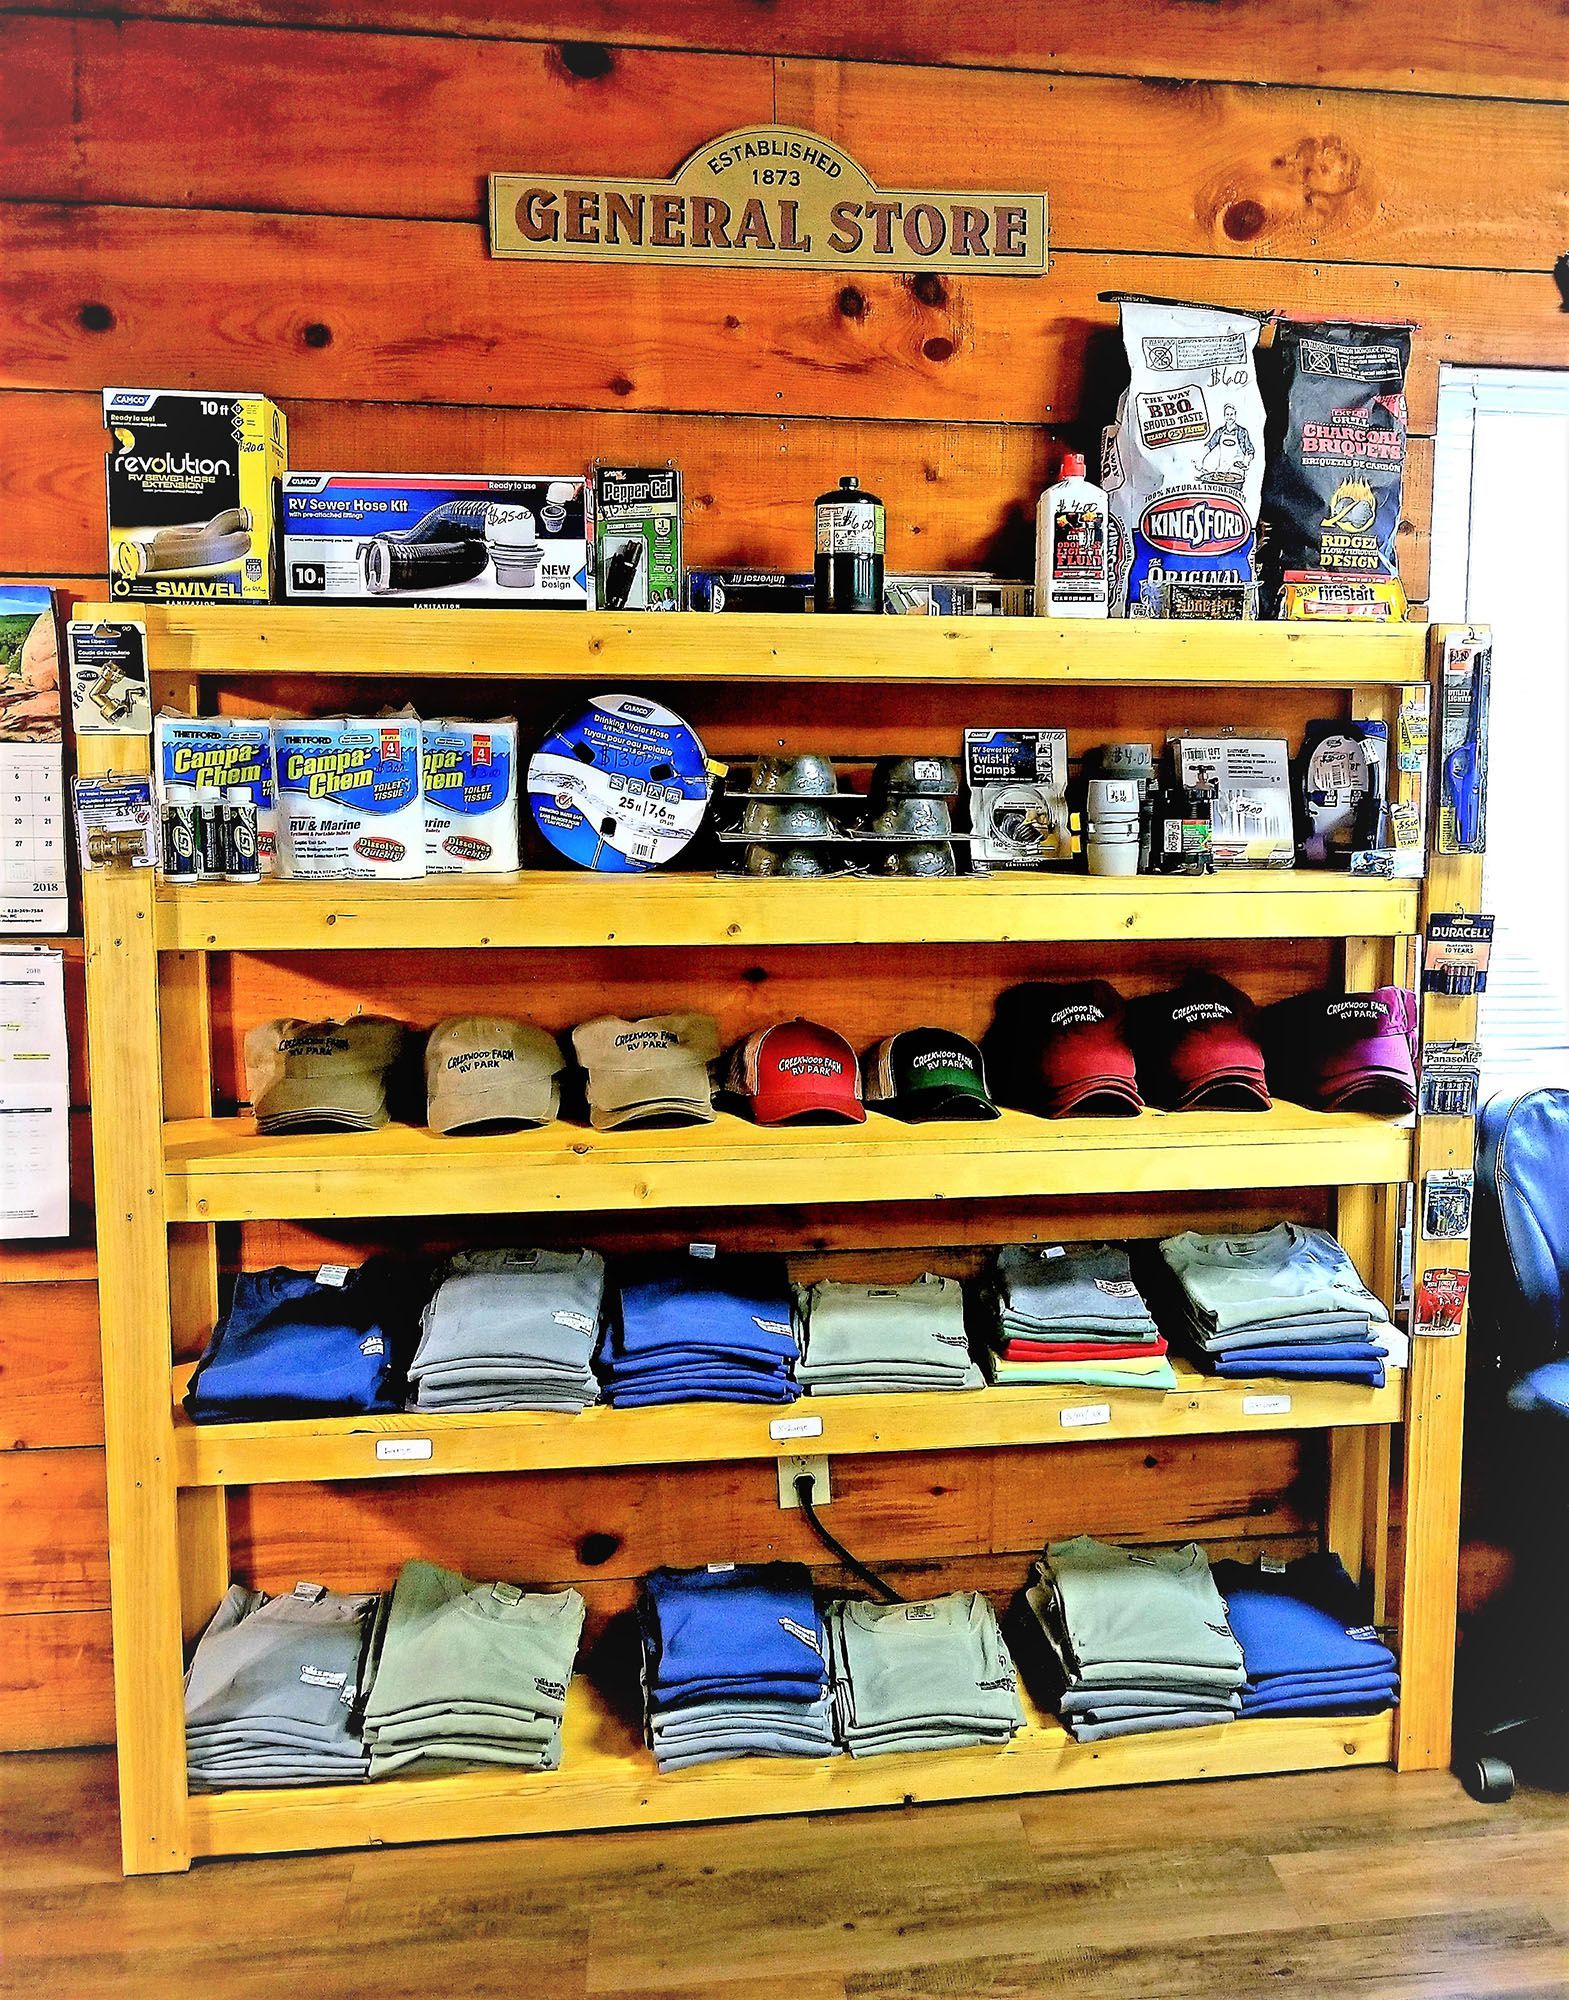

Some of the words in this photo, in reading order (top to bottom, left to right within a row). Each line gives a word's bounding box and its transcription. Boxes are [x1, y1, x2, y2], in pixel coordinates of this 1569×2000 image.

[706, 140, 844, 180] ESTABLISHED
[752, 169, 801, 187] 1873
[514, 188, 810, 253] GENERAL
[827, 202, 1028, 256] STORE
[116, 395, 144, 404] CAMCO
[1167, 390, 1191, 400] WAY
[201, 401, 216, 415] 10
[220, 404, 229, 415] ft
[1148, 399, 1194, 418] BBQ
[111, 414, 131, 422] Ready
[1143, 417, 1176, 431] SHOULD
[1178, 412, 1204, 425] TASTE
[1303, 424, 1400, 445] CHARCOAL
[1303, 438, 1400, 459] BRIQUETS
[114, 452, 230, 476] revolution
[145, 474, 183, 482] SEWER
[291, 478, 317, 486] CAMCO
[142, 481, 204, 489] EXTENSION
[489, 481, 512, 491] Ready
[603, 482, 649, 503] Pepper
[651, 479, 672, 498] Gel
[1165, 484, 1203, 495] NATURAL
[289, 499, 308, 511] RV
[310, 499, 351, 512] Sewer
[354, 500, 388, 512] Hose
[391, 501, 408, 512] Kit
[1150, 501, 1244, 548] KINGSFORD
[1320, 555, 1378, 568] DESIGN
[295, 568, 316, 584] 10
[542, 565, 570, 576] NEW
[542, 581, 571, 590] Design
[744, 575, 785, 584] Universal
[156, 582, 242, 597] SWIVEL
[1318, 585, 1374, 600] firestart
[624, 704, 648, 715] CAMCO
[594, 715, 625, 729] Drinking
[626, 721, 649, 735] Water
[650, 727, 670, 739] Hose
[173, 731, 221, 739] THETFORD
[387, 743, 394, 752] 4
[584, 728, 606, 740] Tuyau
[607, 734, 625, 745] pour
[627, 739, 641, 748] eau
[643, 742, 673, 756] potable
[175, 745, 259, 773] Campa-
[478, 750, 485, 758] 4
[287, 750, 371, 780] Campa-
[974, 765, 1016, 776] Clamps
[196, 765, 260, 787] Chem
[424, 772, 463, 791] hem
[309, 768, 374, 798] Chem
[374, 782, 402, 791] TOILET
[374, 790, 403, 800] TISSUE
[464, 785, 491, 795] TOILET
[464, 792, 492, 802] TISSUE
[619, 797, 634, 809] 25
[649, 804, 666, 819] 7,6
[290, 820, 307, 831] RV
[308, 821, 318, 831] &
[320, 820, 361, 831] Marine
[359, 838, 404, 852] Dissolves
[448, 837, 491, 853] Dissolves
[32, 883, 58, 892] 2018
[1432, 927, 1490, 938] DURACELL
[1172, 1003, 1213, 1021] CREEKWOOD
[1215, 1003, 1232, 1014] FARM
[1327, 1001, 1369, 1015] CREEKWOOD
[1370, 1001, 1388, 1014] FARM
[1062, 1017, 1073, 1026] RV
[1075, 1014, 1097, 1022] PARK
[1186, 1014, 1197, 1023] RV
[1200, 1011, 1224, 1019] PARK
[1341, 1012, 1351, 1020] RV
[1354, 1011, 1378, 1019] PARK
[326, 1038, 348, 1050] FARM
[614, 1030, 658, 1048] CREEKWOOD
[661, 1030, 680, 1045] FARM
[290, 1048, 302, 1056] RV
[305, 1048, 332, 1056] PARK
[627, 1042, 640, 1052] RV
[643, 1041, 668, 1049] PARK
[492, 1049, 514, 1060] FARM
[913, 1051, 956, 1068] CREEKWOOD
[957, 1053, 973, 1069] FARM
[459, 1062, 471, 1074] RV
[474, 1060, 501, 1069] PARK
[778, 1055, 823, 1072] CREEKWOOD
[824, 1057, 842, 1074] FARM
[928, 1061, 940, 1070] RV
[942, 1059, 965, 1069] PARK
[791, 1066, 805, 1076] RV
[808, 1066, 831, 1077] PARK
